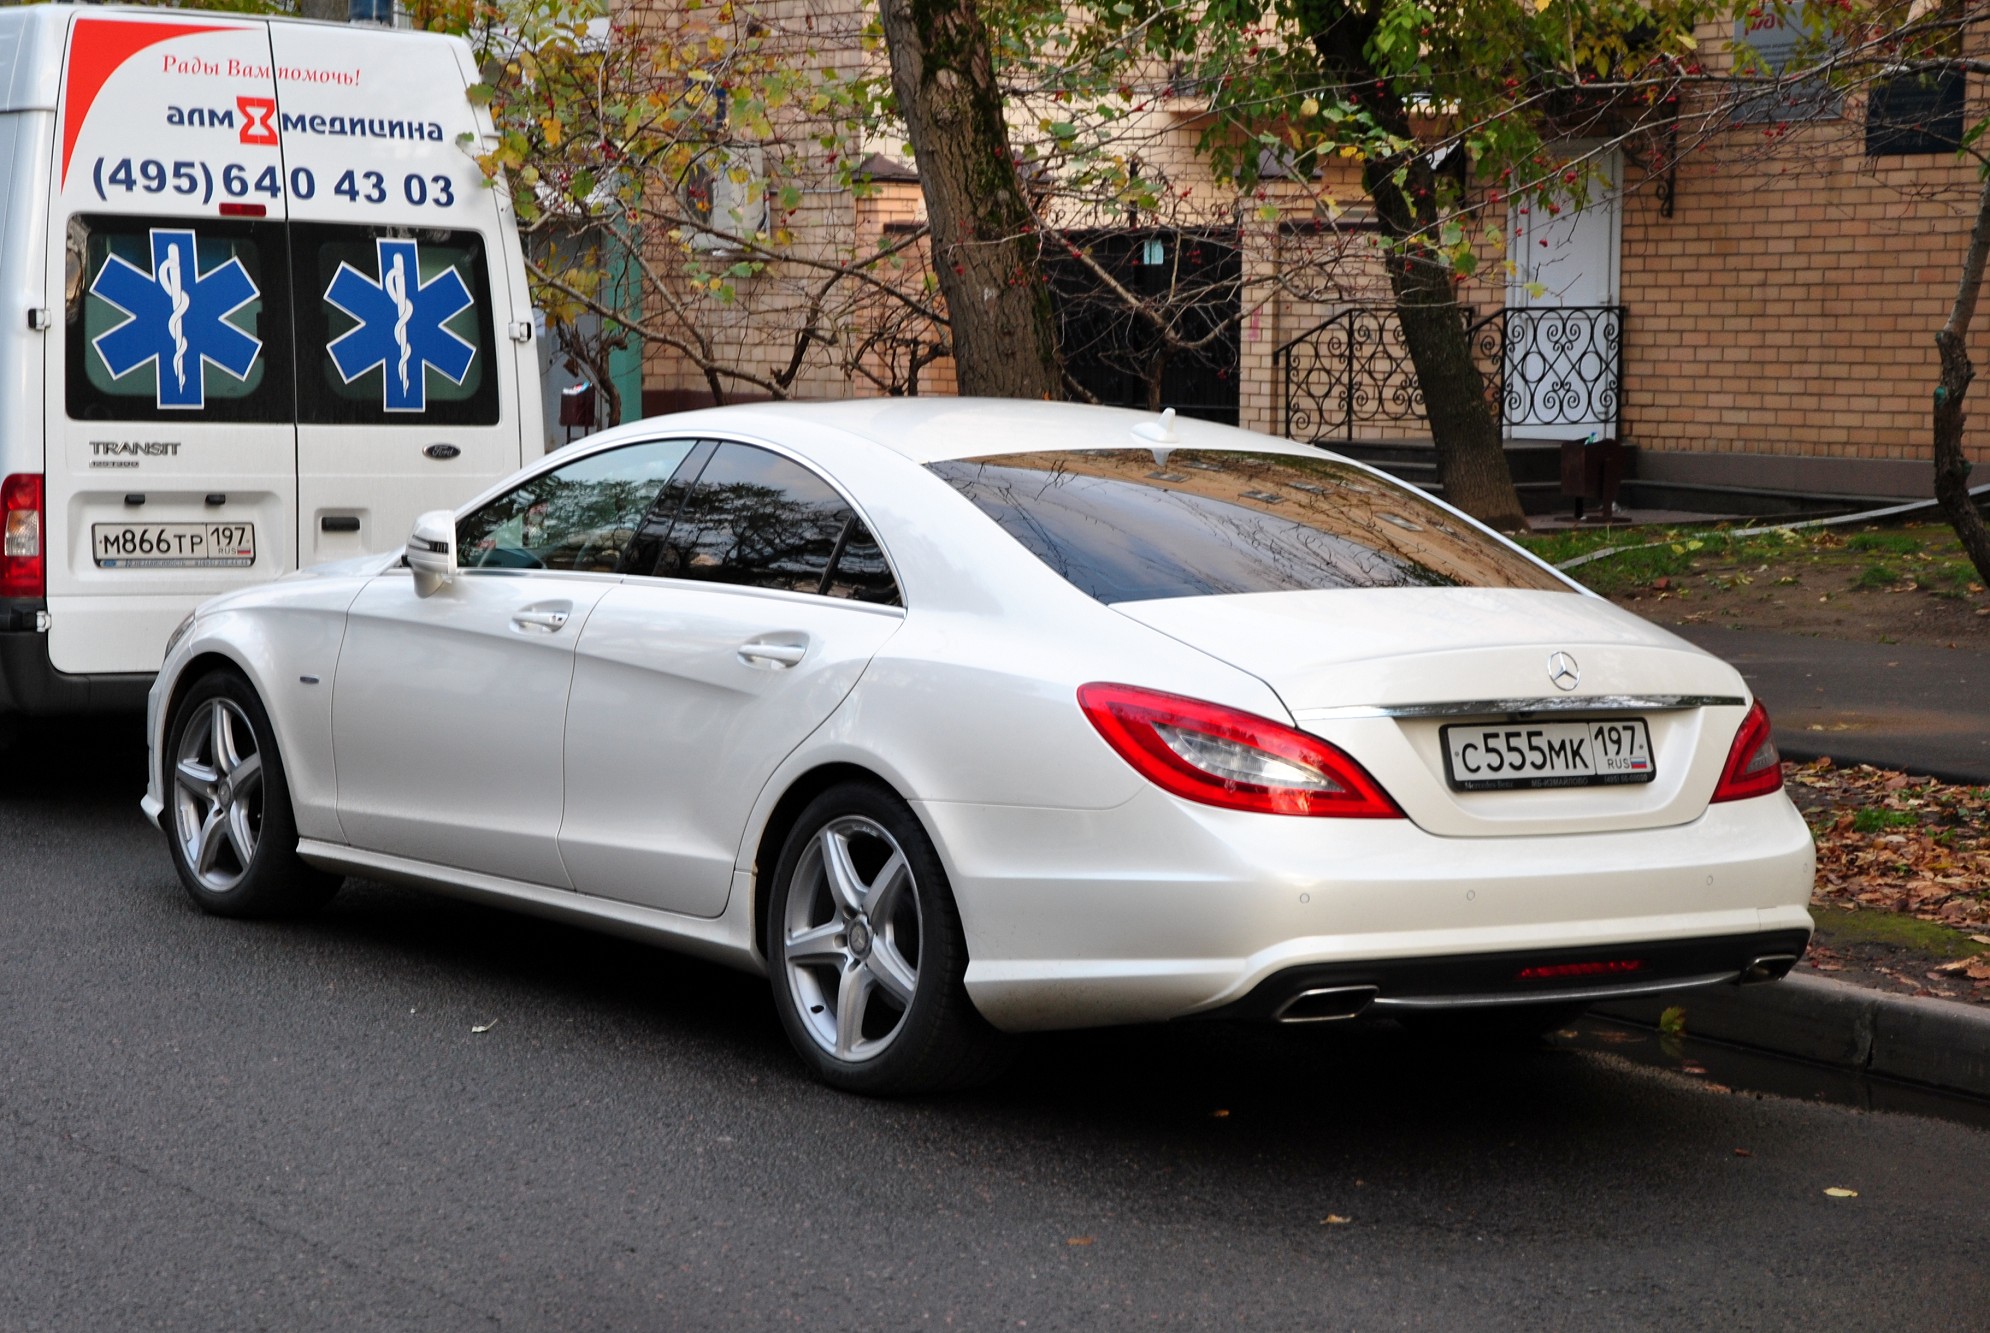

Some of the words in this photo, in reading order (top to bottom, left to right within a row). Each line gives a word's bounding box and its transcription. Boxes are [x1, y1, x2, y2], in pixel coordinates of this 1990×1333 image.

[161, 54, 219, 75] Рады
[227, 58, 271, 79] Вам
[277, 67, 361, 87] помочь!
[282, 112, 443, 142] медицина
[334, 169, 387, 204] 43
[404, 173, 455, 208] 03
[89, 441, 181, 456] TRANSIT
[210, 527, 246, 547] 197
[1594, 725, 1636, 756] 197
[1607, 758, 1630, 769] RUS
